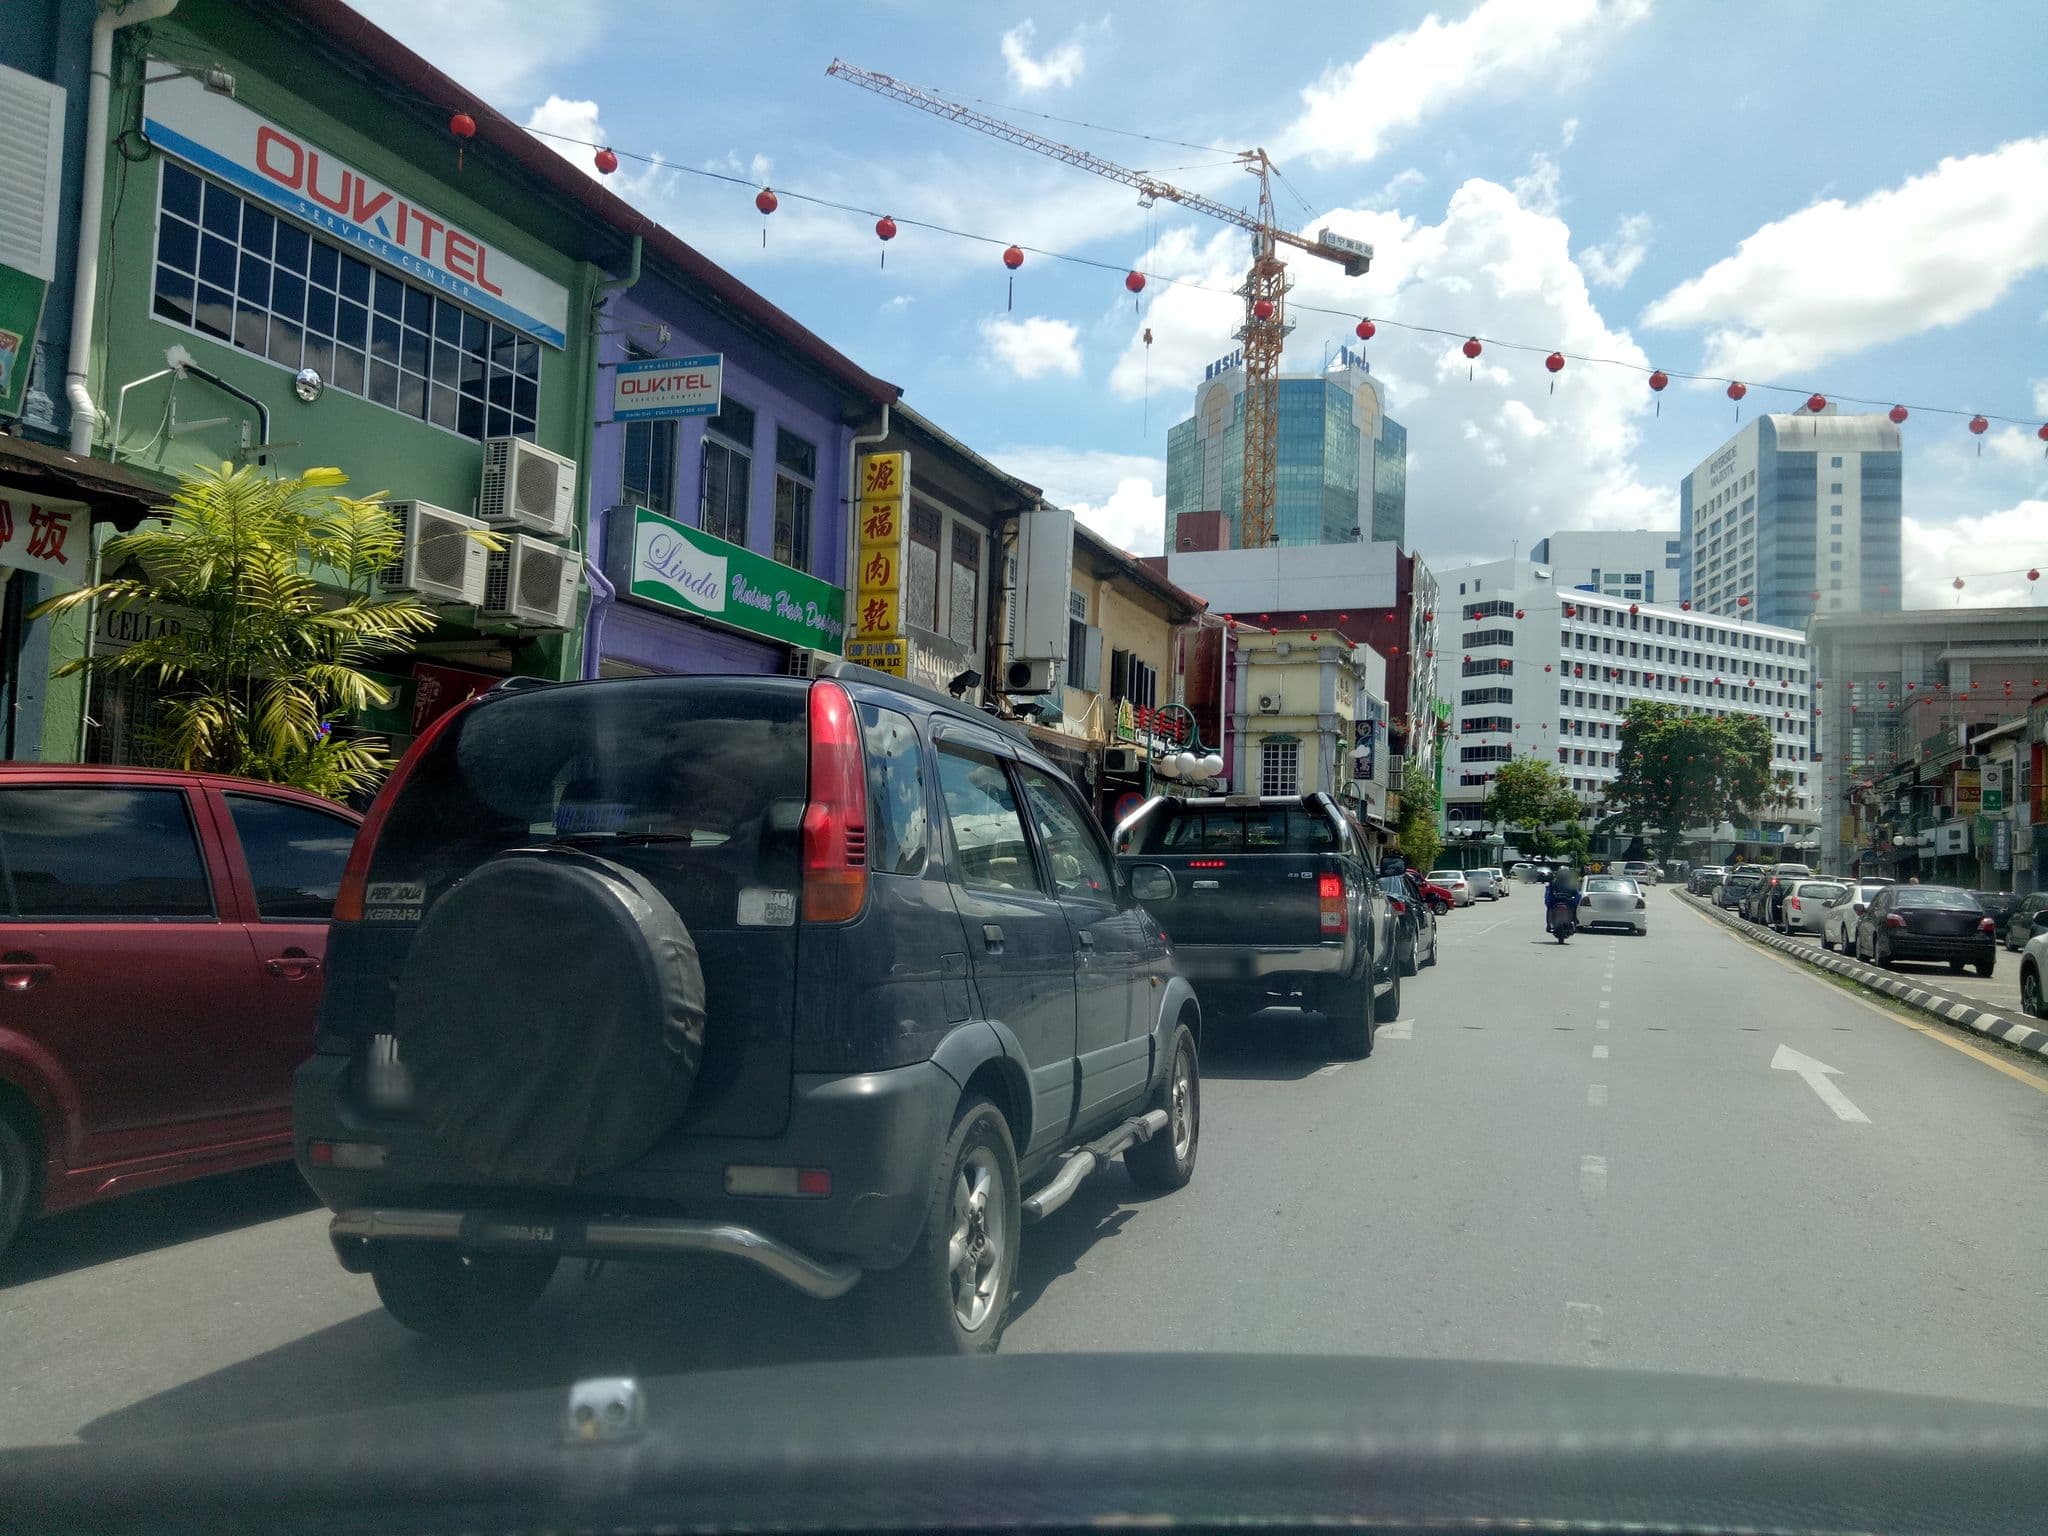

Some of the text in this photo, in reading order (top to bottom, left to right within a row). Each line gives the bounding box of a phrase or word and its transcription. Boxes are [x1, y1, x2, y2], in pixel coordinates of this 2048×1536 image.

[256, 125, 502, 297] OUKITEL
[299, 202, 470, 298] SERVICE CENTER
[621, 373, 712, 395] OUKITEL
[643, 533, 719, 600] Linda
[732, 573, 773, 612] Unisex
[775, 590, 804, 624] Hair
